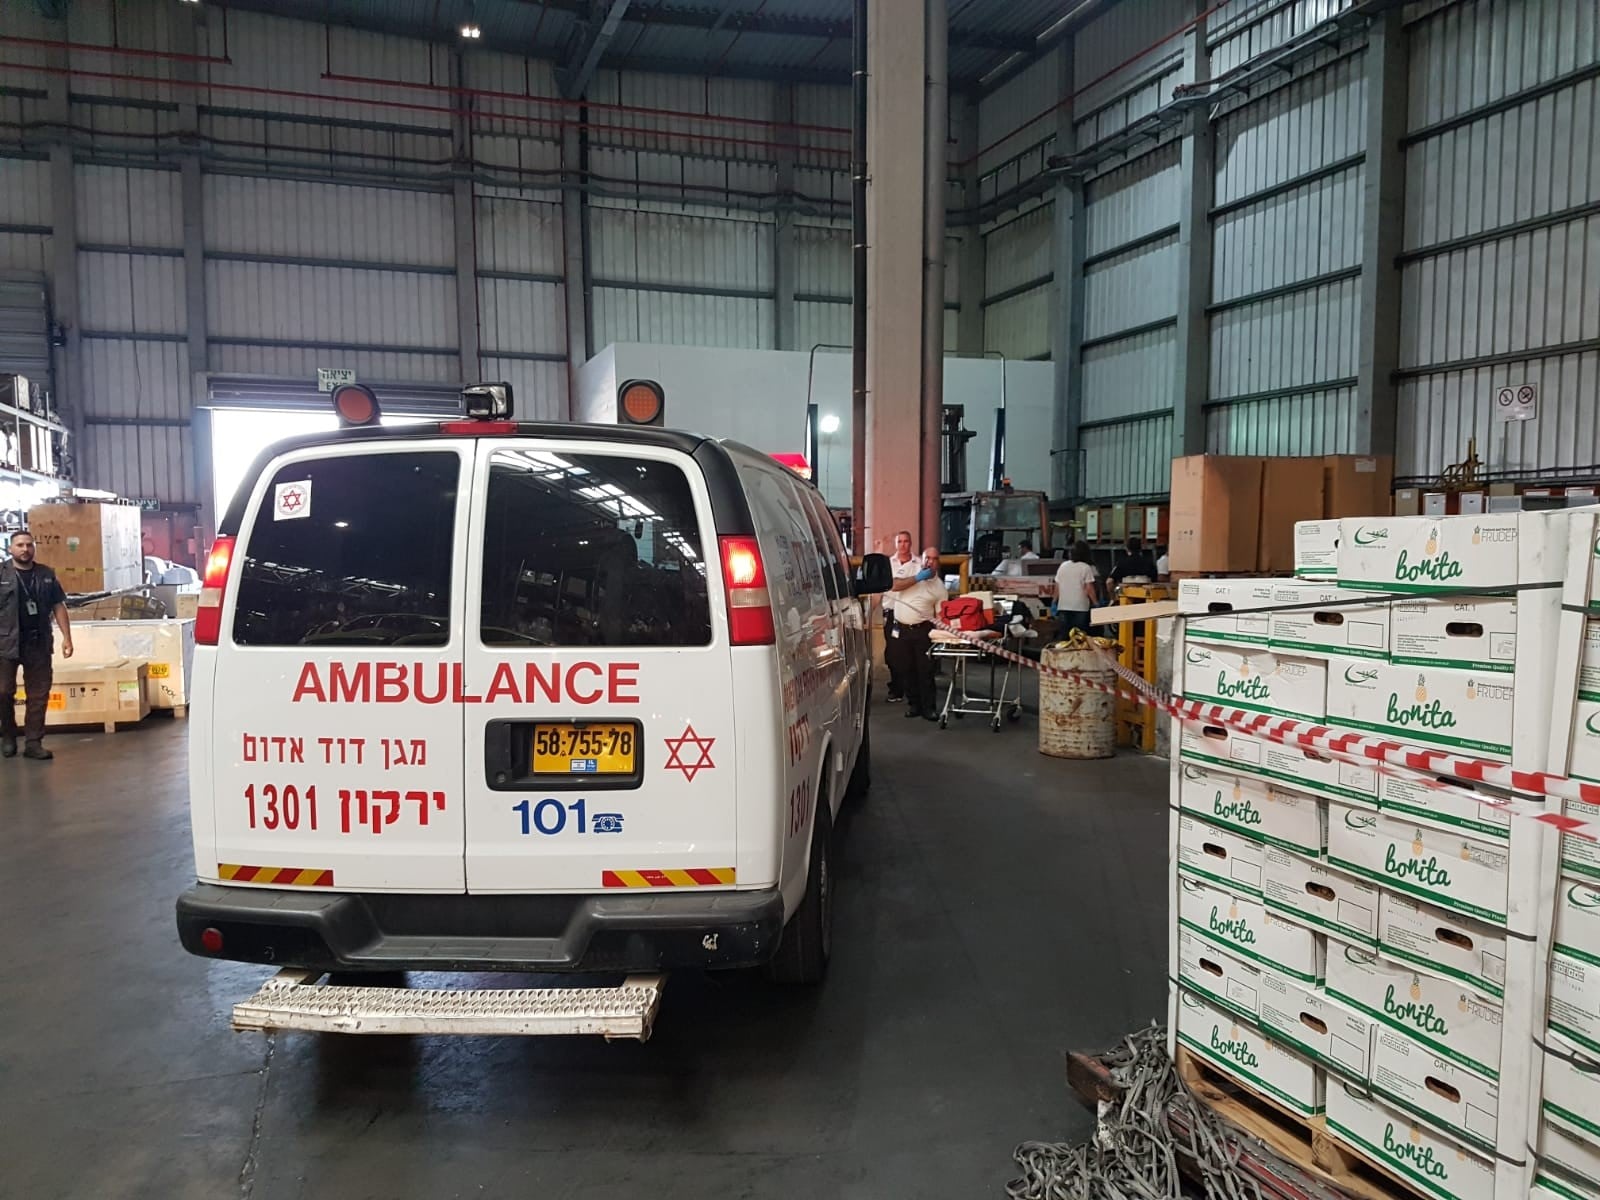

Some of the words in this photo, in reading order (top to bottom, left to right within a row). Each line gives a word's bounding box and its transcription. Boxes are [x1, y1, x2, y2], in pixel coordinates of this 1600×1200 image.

[322, 369, 352, 380] יציאה
[1481, 531, 1517, 542] FRUDEP
[1395, 549, 1463, 582] bonita
[292, 661, 640, 704] AMBULANCE
[1217, 670, 1270, 700] bonita
[1387, 692, 1457, 729] bonita
[242, 732, 304, 763] אדום
[317, 738, 364, 764] דוד
[380, 739, 427, 771] מגן
[244, 783, 317, 830] 1301
[338, 789, 447, 834] ירקון
[512, 798, 588, 835] 101
[1213, 790, 1262, 825] bonita
[1384, 843, 1451, 887] bonita
[1209, 906, 1256, 944] bonita
[1383, 983, 1448, 1036] bonita
[1210, 1024, 1259, 1068] bonita
[1383, 1122, 1448, 1180] bonita
